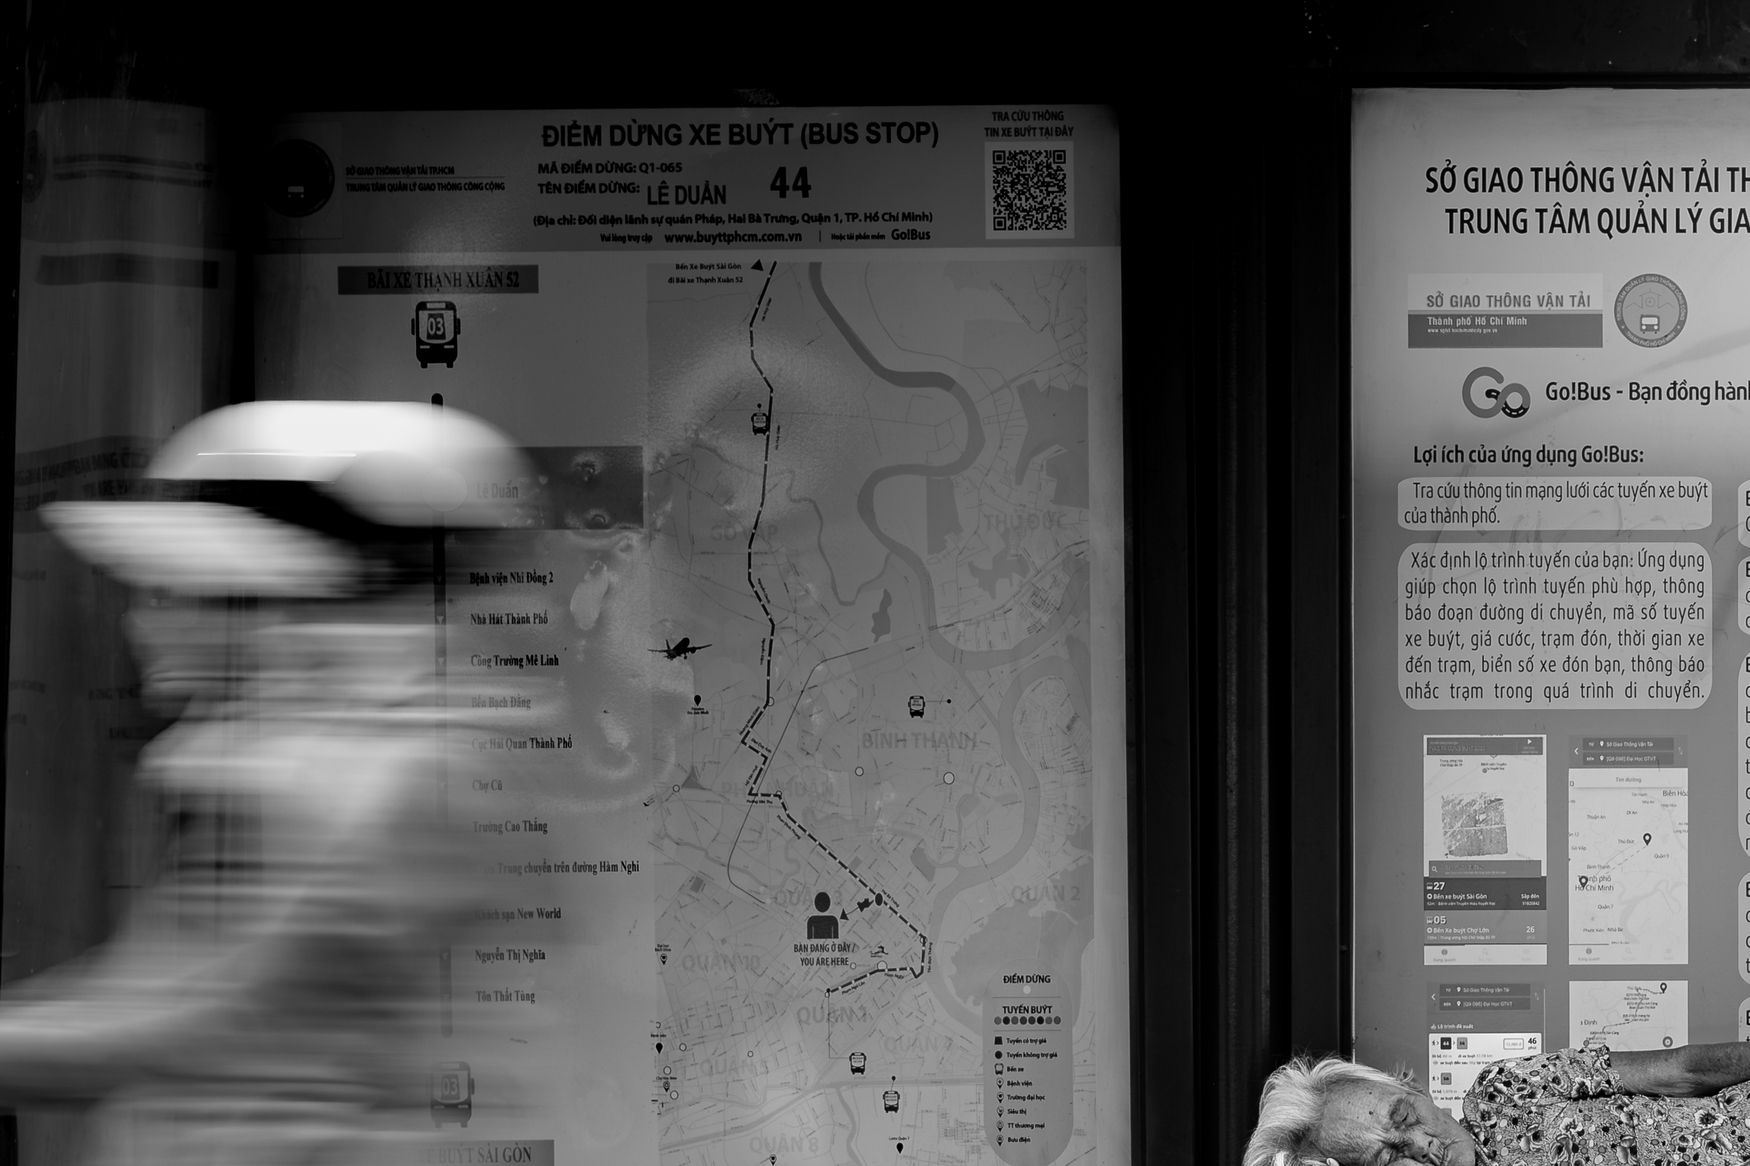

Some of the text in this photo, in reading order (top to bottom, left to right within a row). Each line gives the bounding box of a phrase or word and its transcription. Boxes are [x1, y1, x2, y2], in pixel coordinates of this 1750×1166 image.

[992, 109, 1064, 121] TRA CỨU THÔNG
[542, 118, 938, 150] ĐIỂM DỪNG XE BUÝT (BUS STOP)
[984, 125, 1073, 139] TIN XE BUÝT TẠI ĐÂY
[538, 159, 682, 174] MÃ ĐIỂM DỪNG: Q1-065
[770, 167, 811, 198] 44
[1426, 159, 1456, 193] SỞ
[1464, 167, 1523, 193] GIAO
[1530, 161, 1614, 192] THÔNG
[1621, 161, 1673, 197] VẬN
[1681, 159, 1719, 192] TẢI
[538, 181, 562, 194] TÊN
[564, 180, 596, 194] ĐIỂM
[599, 181, 640, 193] DỪNG:
[647, 180, 670, 205] LÊ
[695, 213, 725, 226] Pháp,
[728, 213, 746, 223] Hai
[748, 212, 762, 223] Bà
[763, 212, 799, 226] Trưng,
[802, 213, 831, 226] Quận
[881, 211, 899, 222] Chí
[902, 211, 933, 224] Minh)
[1445, 208, 1527, 234] TRUNG
[1535, 202, 1590, 233] TÂM
[1597, 200, 1667, 240] QUẢN
[1676, 201, 1703, 233] LÝ
[664, 230, 802, 245] www.buyttphcm.com.vn
[891, 229, 931, 240] Go!Bus
[368, 266, 519, 292] BÃI XE THẠNH XUÂN 52
[1427, 291, 1590, 310] SỞ GIAO THÔNG VẬN TẢI
[428, 318, 444, 335] 03
[1427, 316, 1527, 327] Thành phố Hồ Chí Minh
[1546, 382, 1611, 400] Go!Bus
[1629, 382, 1662, 404] Bạn
[1666, 379, 1710, 406] đồng
[1414, 444, 1643, 468] Lợi ích của ứng dụng Go!Bus:
[1433, 882, 1446, 891] 27
[1433, 916, 1446, 925] 05
[476, 947, 546, 963] Nguyễn Thị Nghĩa
